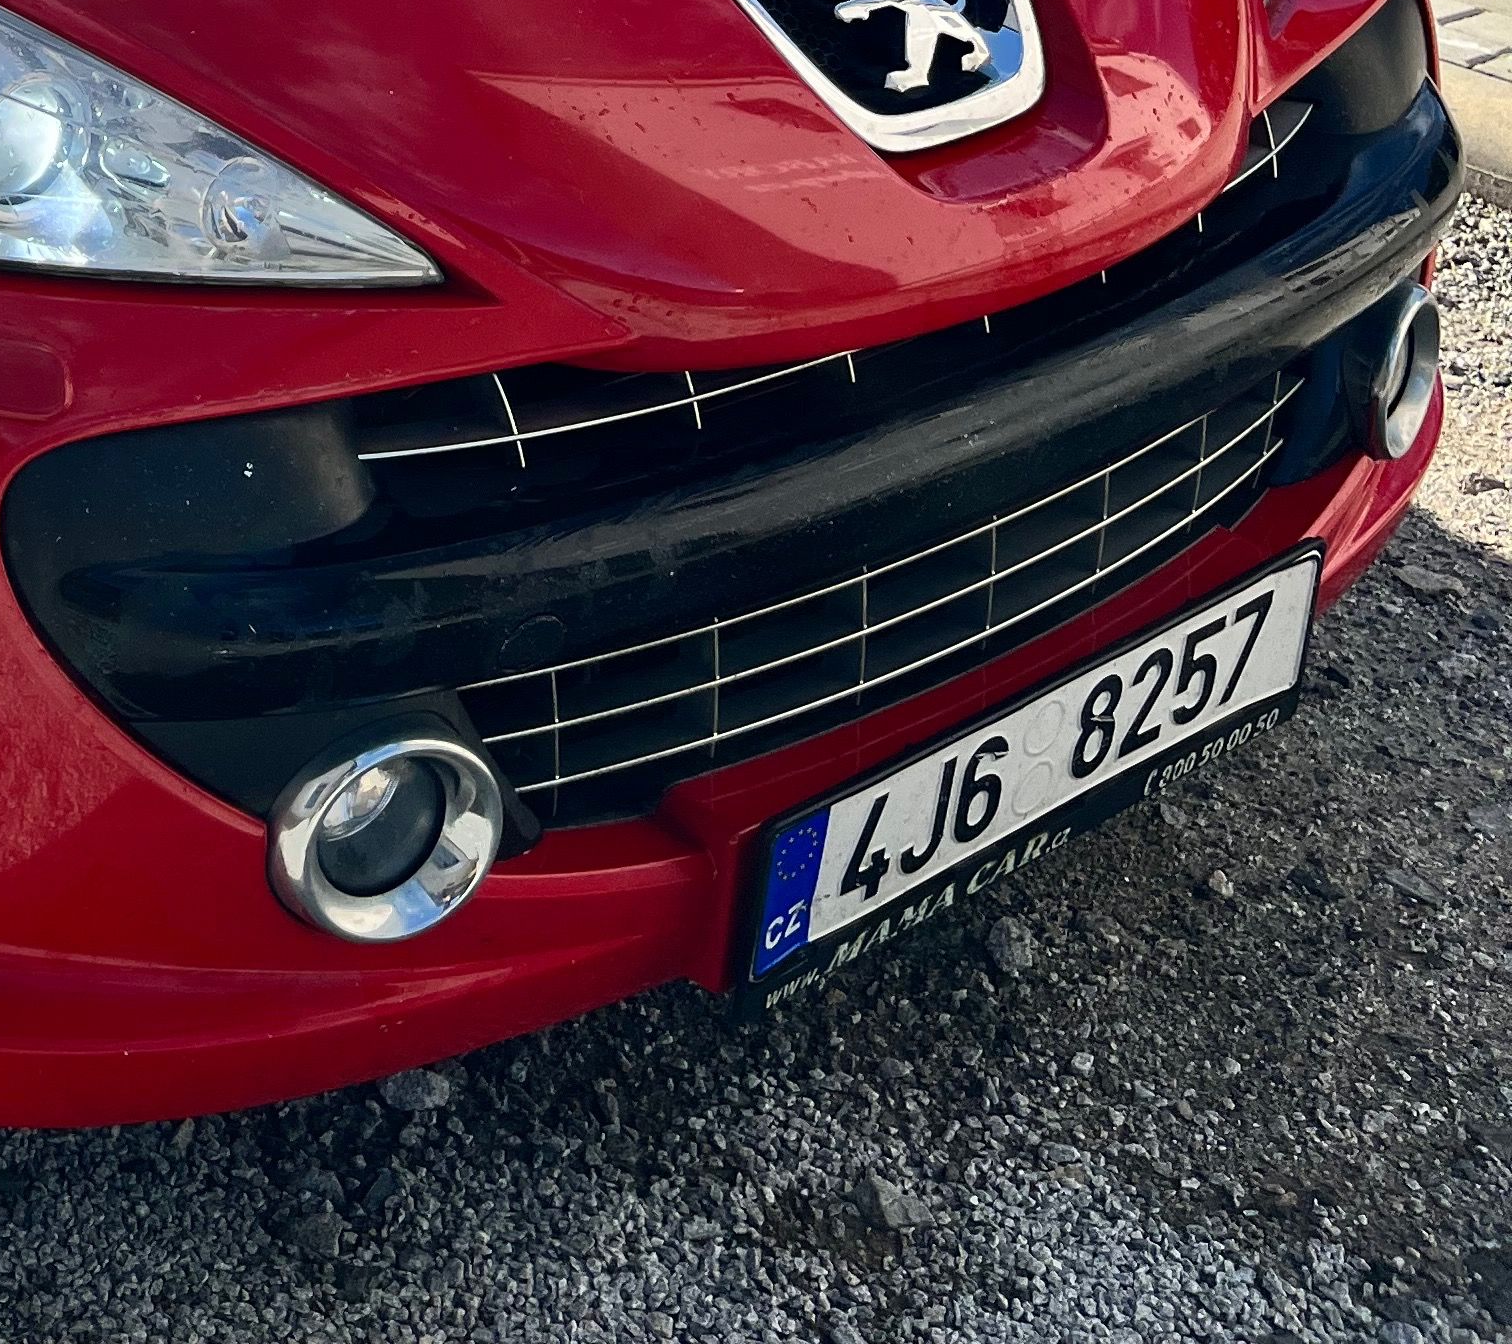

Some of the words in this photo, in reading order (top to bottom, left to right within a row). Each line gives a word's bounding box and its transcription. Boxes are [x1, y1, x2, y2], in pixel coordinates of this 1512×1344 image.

[839, 736, 1010, 902] 4J6
[1071, 589, 1275, 780] 8257
[765, 899, 807, 950] CZ
